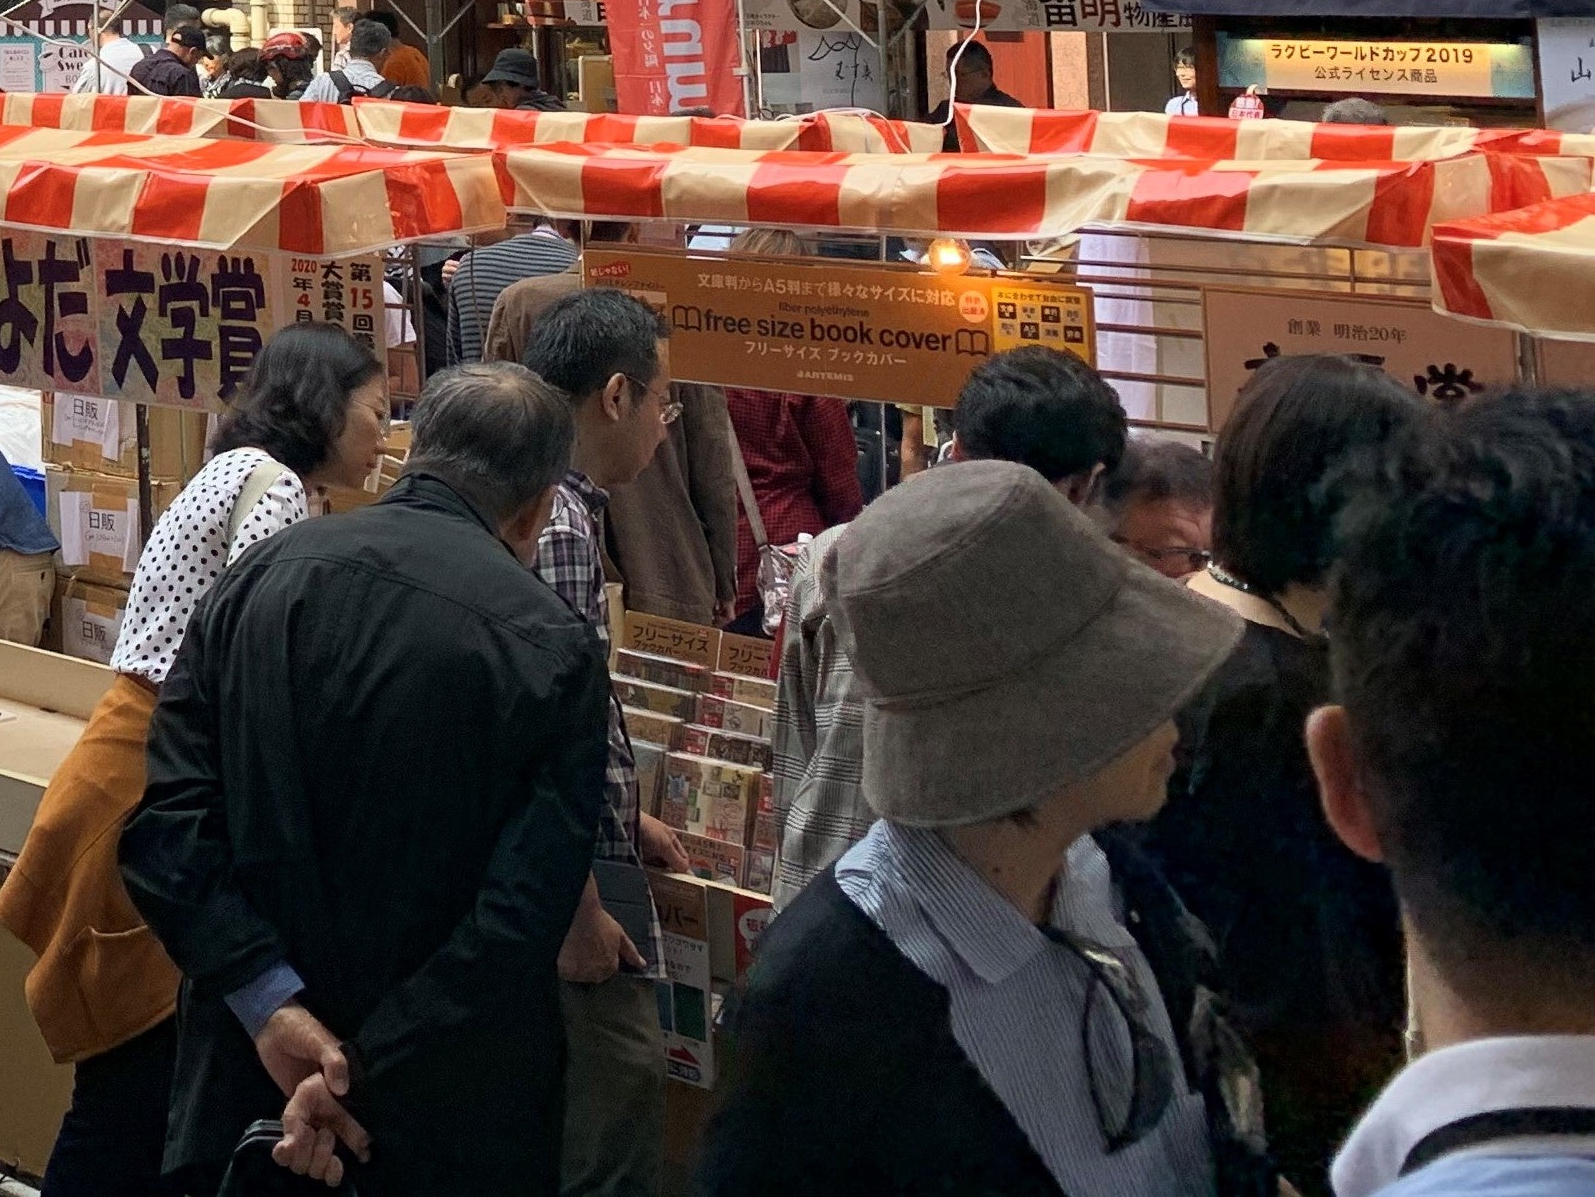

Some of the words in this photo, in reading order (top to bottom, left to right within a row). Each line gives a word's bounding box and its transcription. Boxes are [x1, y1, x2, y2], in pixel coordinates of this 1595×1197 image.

[1270, 42, 1474, 64] ラグビーワールドカップ2019
[57, 61, 84, 72] Swe
[1314, 65, 1438, 84] 公式ライセンス商品
[320, 260, 346, 328] 大賞賞
[697, 272, 956, 307] 文庫判からA5判まで様々なサイズに対応
[704, 308, 752, 335] free
[756, 314, 805, 340] size
[810, 317, 875, 346] book
[878, 328, 953, 353] cover
[1286, 318, 1322, 337] 創業
[1333, 322, 1408, 344] 明治20年
[744, 340, 822, 361] フリーサイズ
[828, 348, 908, 366] ブックカバー
[73, 398, 99, 421] 日販
[88, 511, 116, 532] 日販
[82, 620, 107, 642] 日販
[632, 625, 709, 653] フリーサイズ
